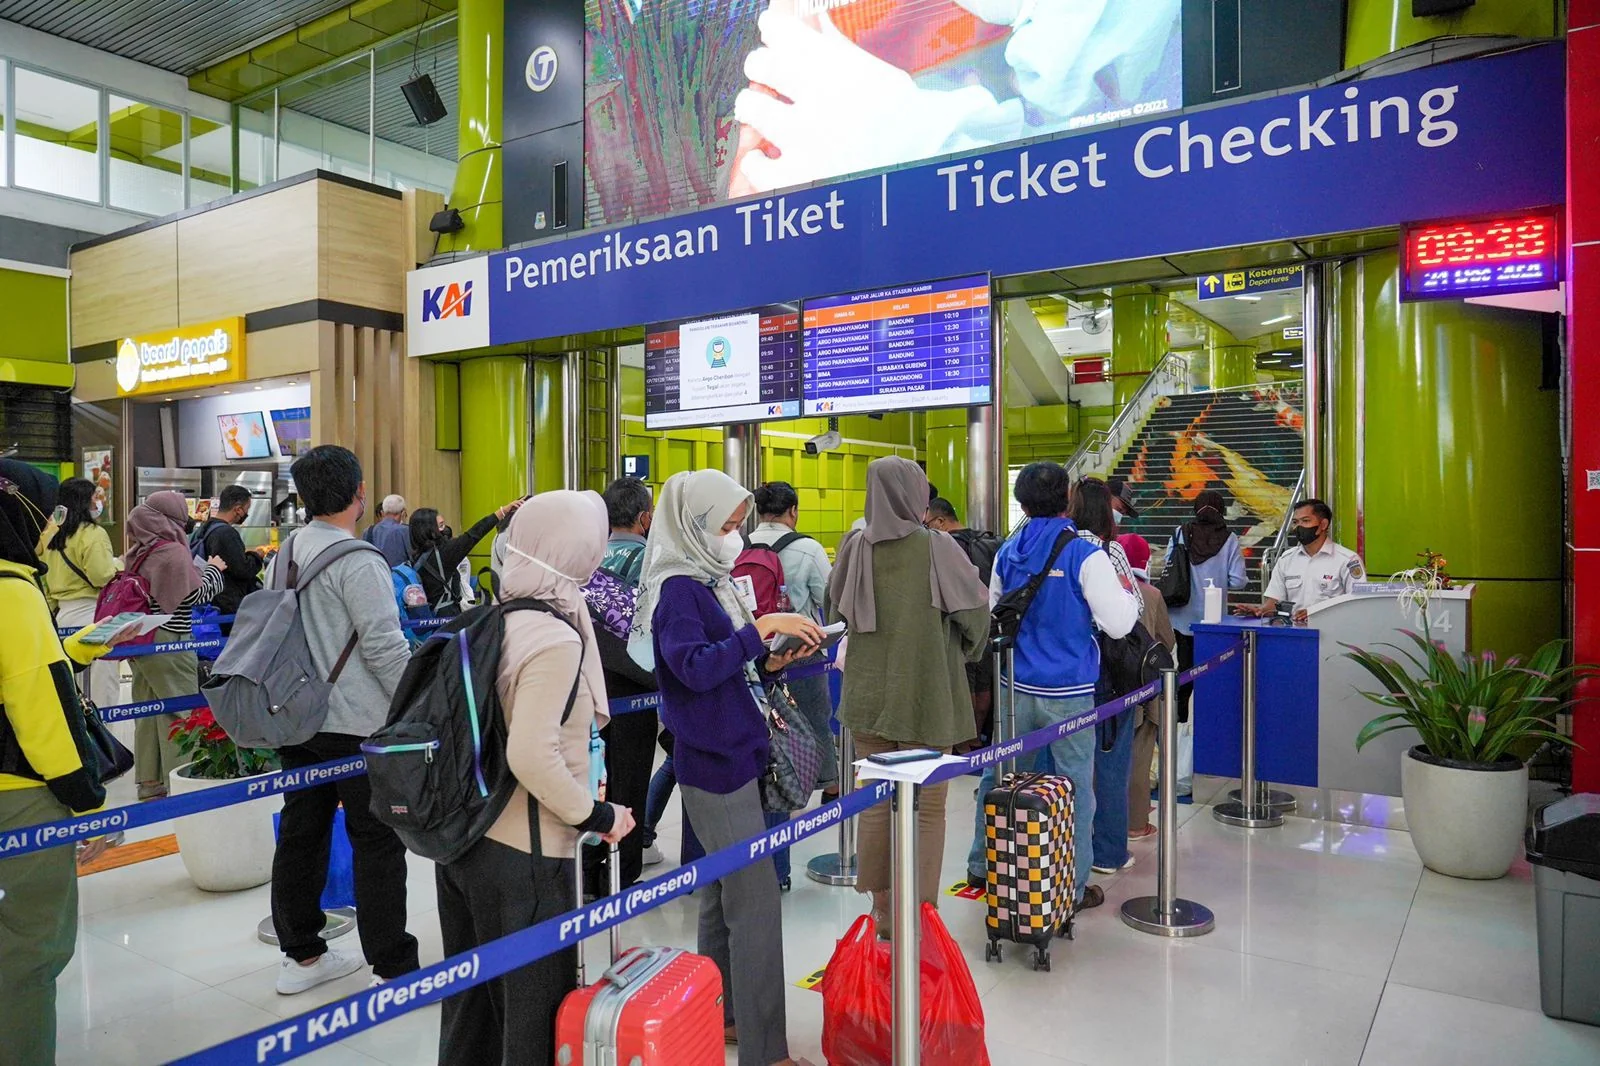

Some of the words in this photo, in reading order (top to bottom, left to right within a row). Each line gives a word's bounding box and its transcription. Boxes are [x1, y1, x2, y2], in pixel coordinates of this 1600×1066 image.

[937, 142, 1106, 211] Ticket
[1134, 86, 1458, 178] Checking
[506, 224, 718, 292] Pemeriksaan
[736, 190, 844, 246] Tiket
[1249, 276, 1288, 286] Departures
[422, 280, 472, 322] KAI
[851, 292, 869, 301] DAFTAR
[870, 291, 884, 299] JALUR
[892, 288, 912, 296] STASIUN
[913, 285, 932, 293] GAMBIR
[818, 326, 831, 335] ARGO
[832, 323, 869, 333] PARAHYANGAN
[888, 318, 914, 326] BANDUNG
[818, 337, 831, 346] ARGO
[832, 334, 869, 344] PARAHYANGAN
[888, 329, 914, 337] BANDUNG
[141, 337, 180, 365] beard
[180, 329, 228, 365] papa's
[832, 345, 869, 354] PARAHYANGAN
[832, 357, 869, 365] PARAHYANGAN
[877, 364, 903, 372] SURABAYA
[832, 378, 869, 387] PARAHYANGAN
[881, 373, 923, 382] KIARACONDONG
[879, 386, 905, 394] SURABAYA
[1415, 610, 1452, 632] 04
[185, 640, 220, 649] (Persero)
[108, 700, 165, 720] (Persero)
[631, 698, 642, 708] PT
[644, 696, 659, 707] KAI
[1058, 724, 1067, 735] PT
[1068, 720, 1076, 731] KAI
[1076, 712, 1098, 728] (Persero)
[970, 753, 980, 768] PT
[982, 749, 994, 764] KAI
[995, 739, 1023, 761] (Persero)
[248, 780, 269, 796] PT
[273, 774, 300, 790] KAI
[305, 759, 368, 783] (Persero)
[876, 782, 887, 799] PT
[36, 810, 129, 847] (Persero)
[750, 838, 767, 859] PT
[770, 828, 791, 849] KAI
[794, 802, 842, 838] (Persero)
[560, 914, 585, 941] PT
[589, 898, 621, 928] KAI
[625, 866, 697, 914] (Persero)
[256, 1026, 298, 1063] PT
[307, 1002, 358, 1042] KAI
[367, 953, 480, 1021] (Persero)
